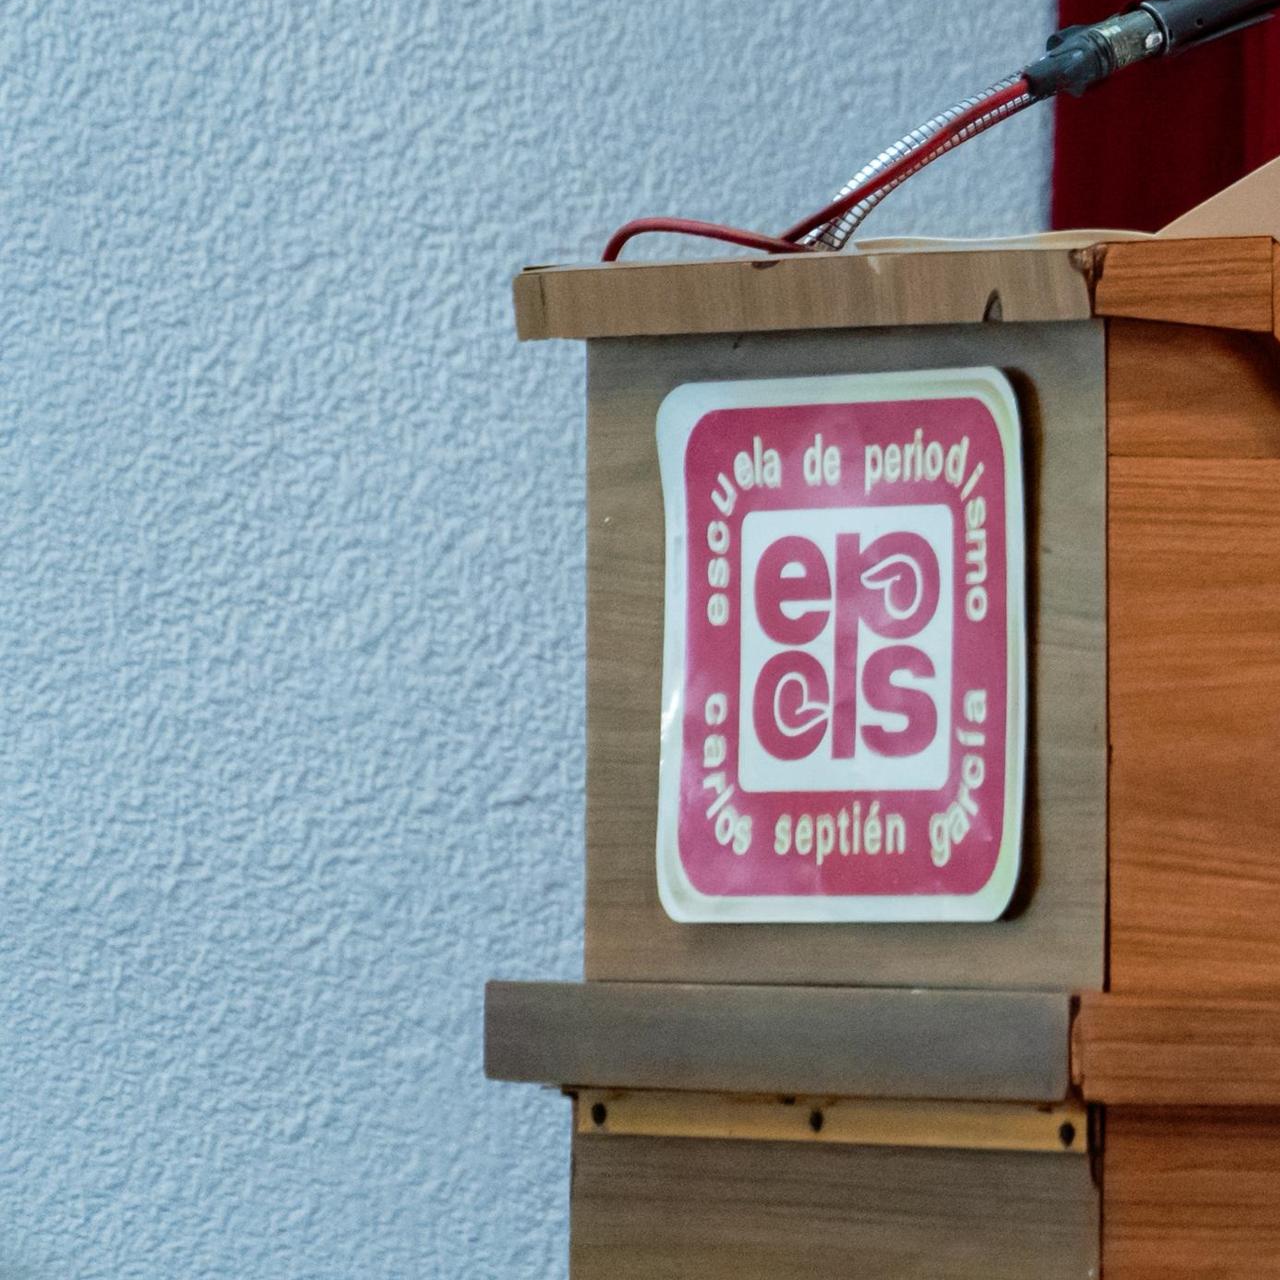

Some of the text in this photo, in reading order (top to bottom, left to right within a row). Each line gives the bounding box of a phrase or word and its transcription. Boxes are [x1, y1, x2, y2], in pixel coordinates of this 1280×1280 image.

[706, 428, 989, 628] escuela de periodismo
[702, 688, 988, 868] carlos septién garcía
